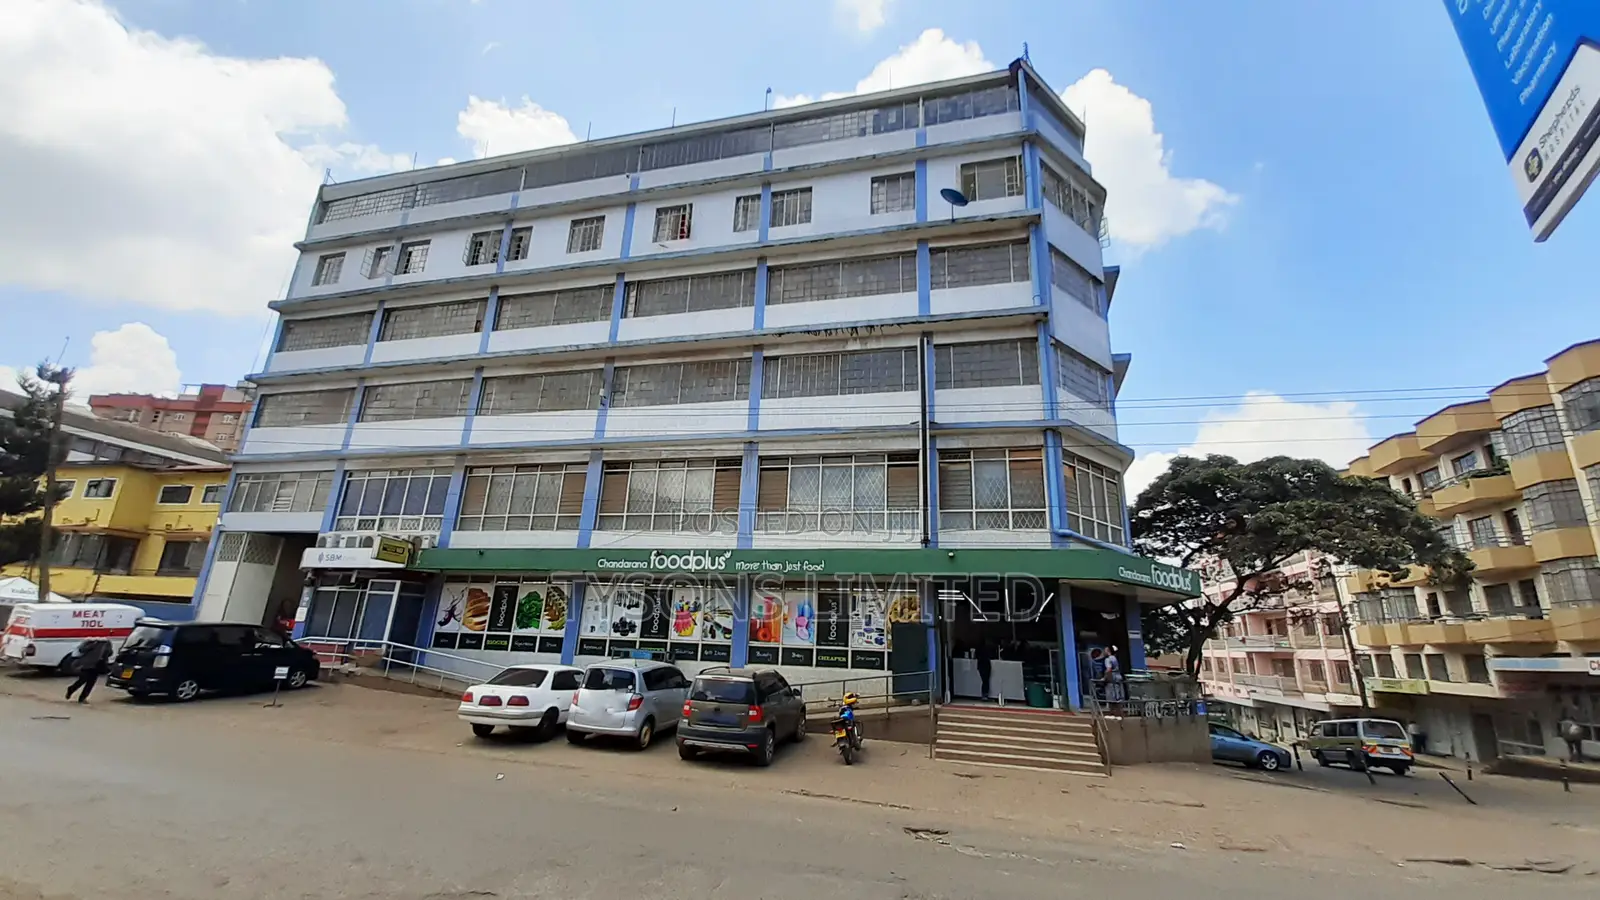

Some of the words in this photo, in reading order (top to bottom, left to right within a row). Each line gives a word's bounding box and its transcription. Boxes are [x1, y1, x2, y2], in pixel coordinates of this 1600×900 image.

[597, 558, 648, 569] Chandarana
[650, 550, 726, 572] foodplus
[762, 560, 782, 571] than
[803, 560, 825, 571] food
[72, 610, 106, 618] MEAT
